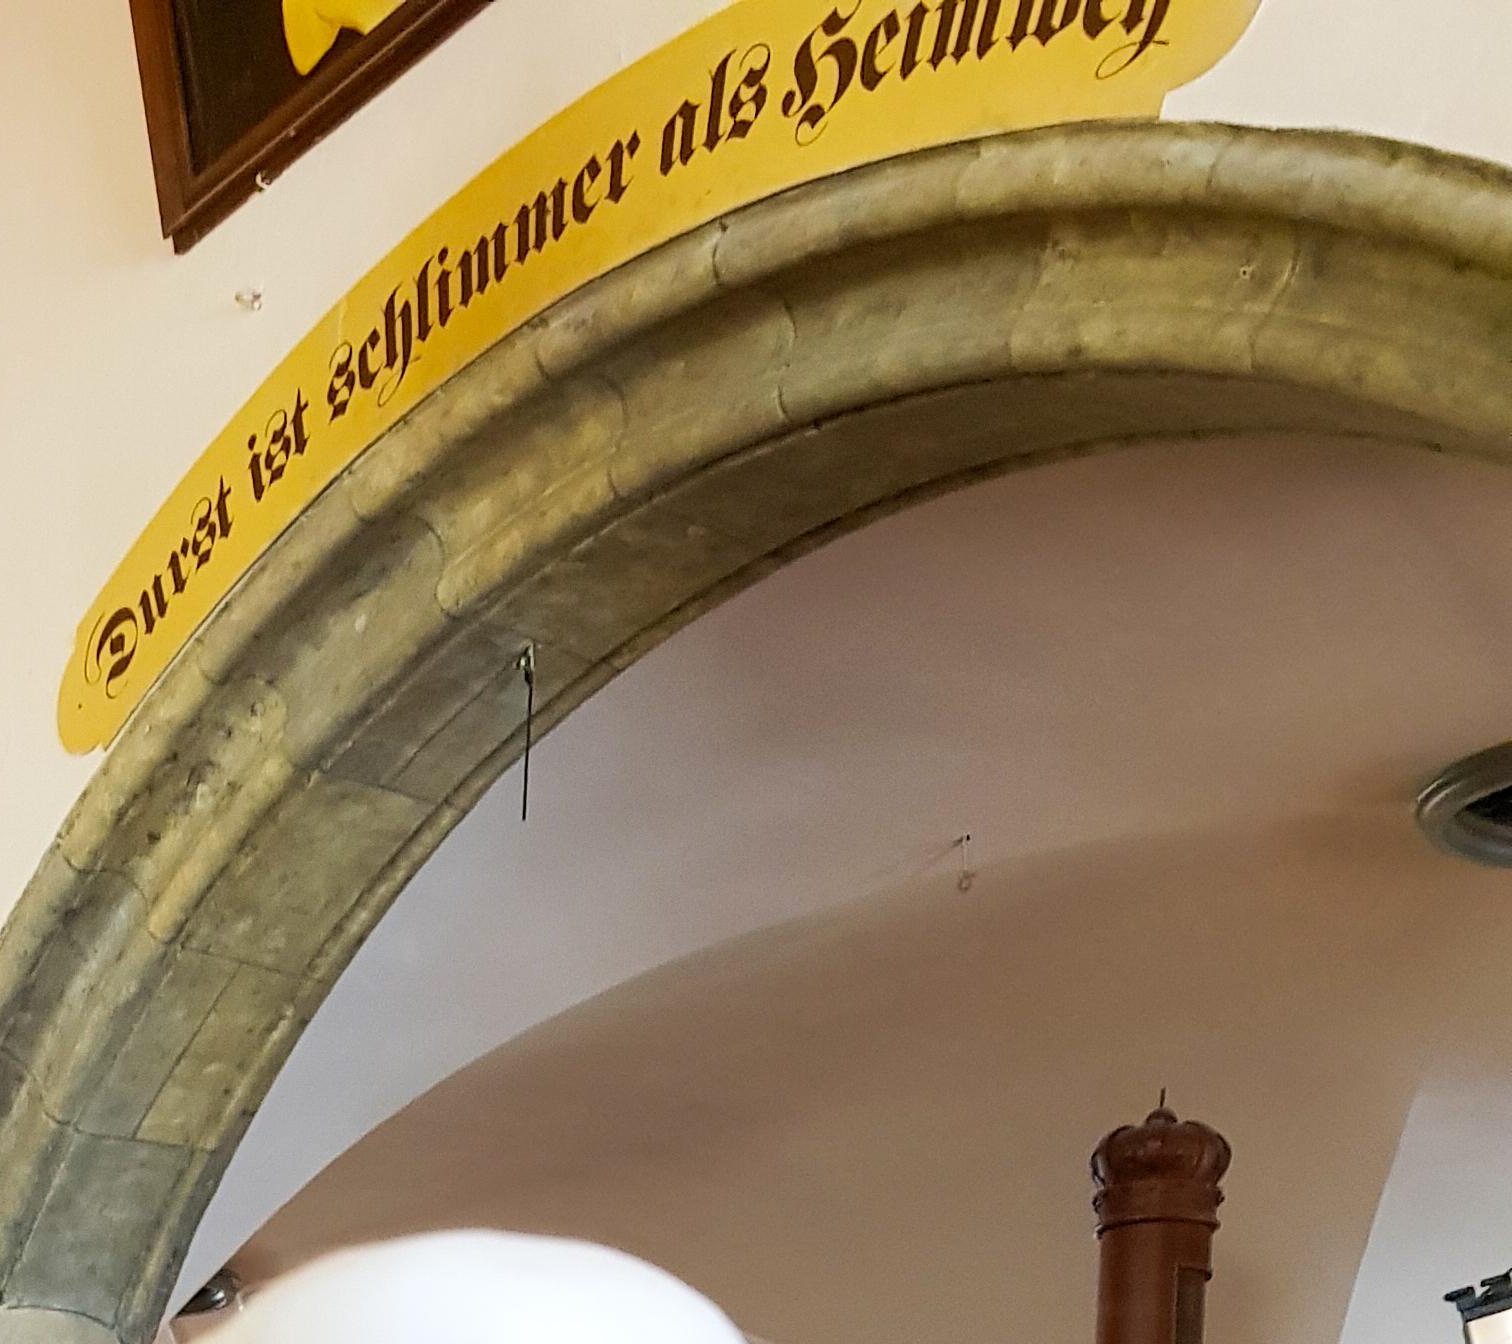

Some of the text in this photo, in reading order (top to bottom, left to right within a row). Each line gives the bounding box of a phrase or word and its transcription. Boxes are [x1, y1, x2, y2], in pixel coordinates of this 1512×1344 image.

[85, 475, 234, 699] Durst
[247, 386, 311, 503] ist
[326, 129, 641, 424] schlimmer
[659, 43, 771, 177] als
